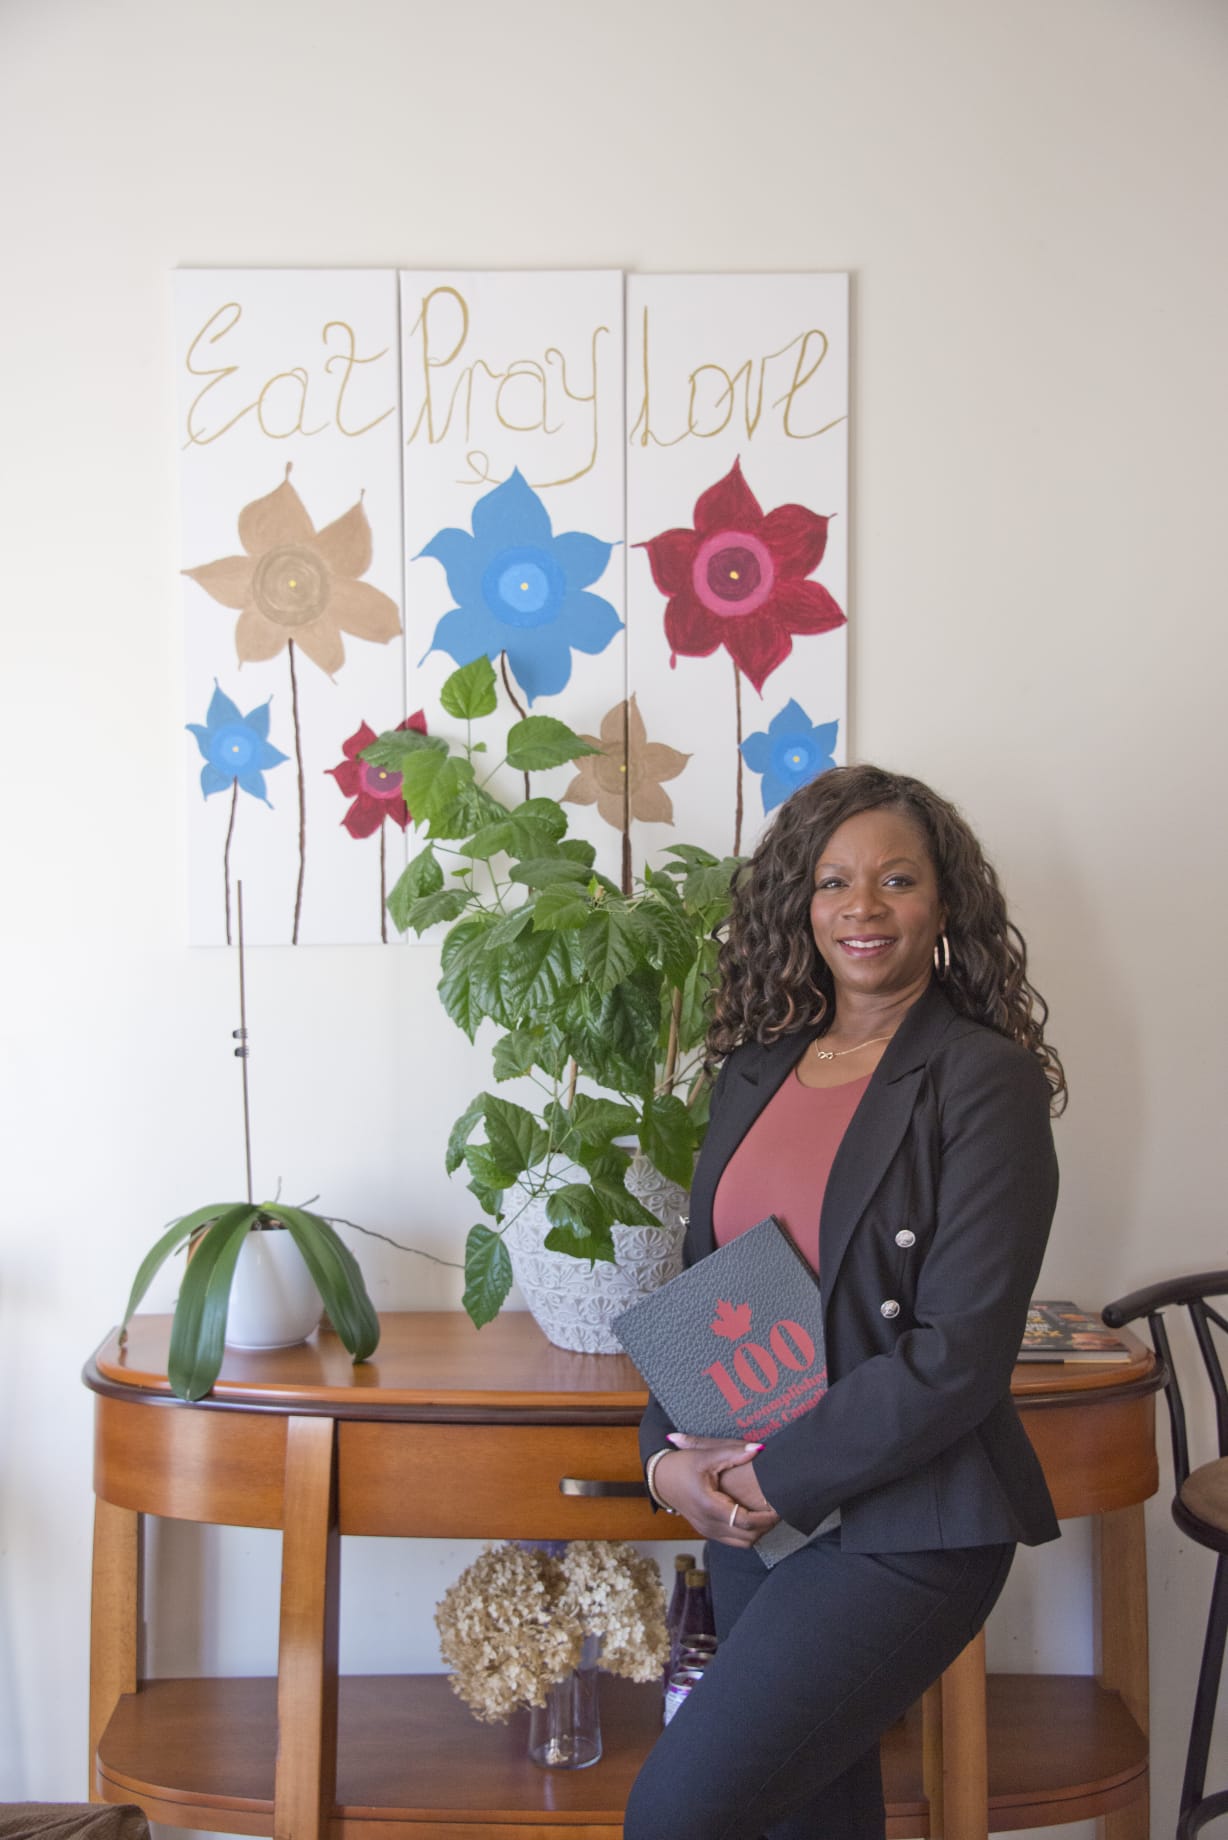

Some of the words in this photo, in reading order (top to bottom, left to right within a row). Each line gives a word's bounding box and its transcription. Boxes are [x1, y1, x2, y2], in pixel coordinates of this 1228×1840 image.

[181, 302, 395, 450] Eat
[407, 286, 609, 486] Pray
[630, 305, 847, 447] Love
[703, 1320, 815, 1415] 100
